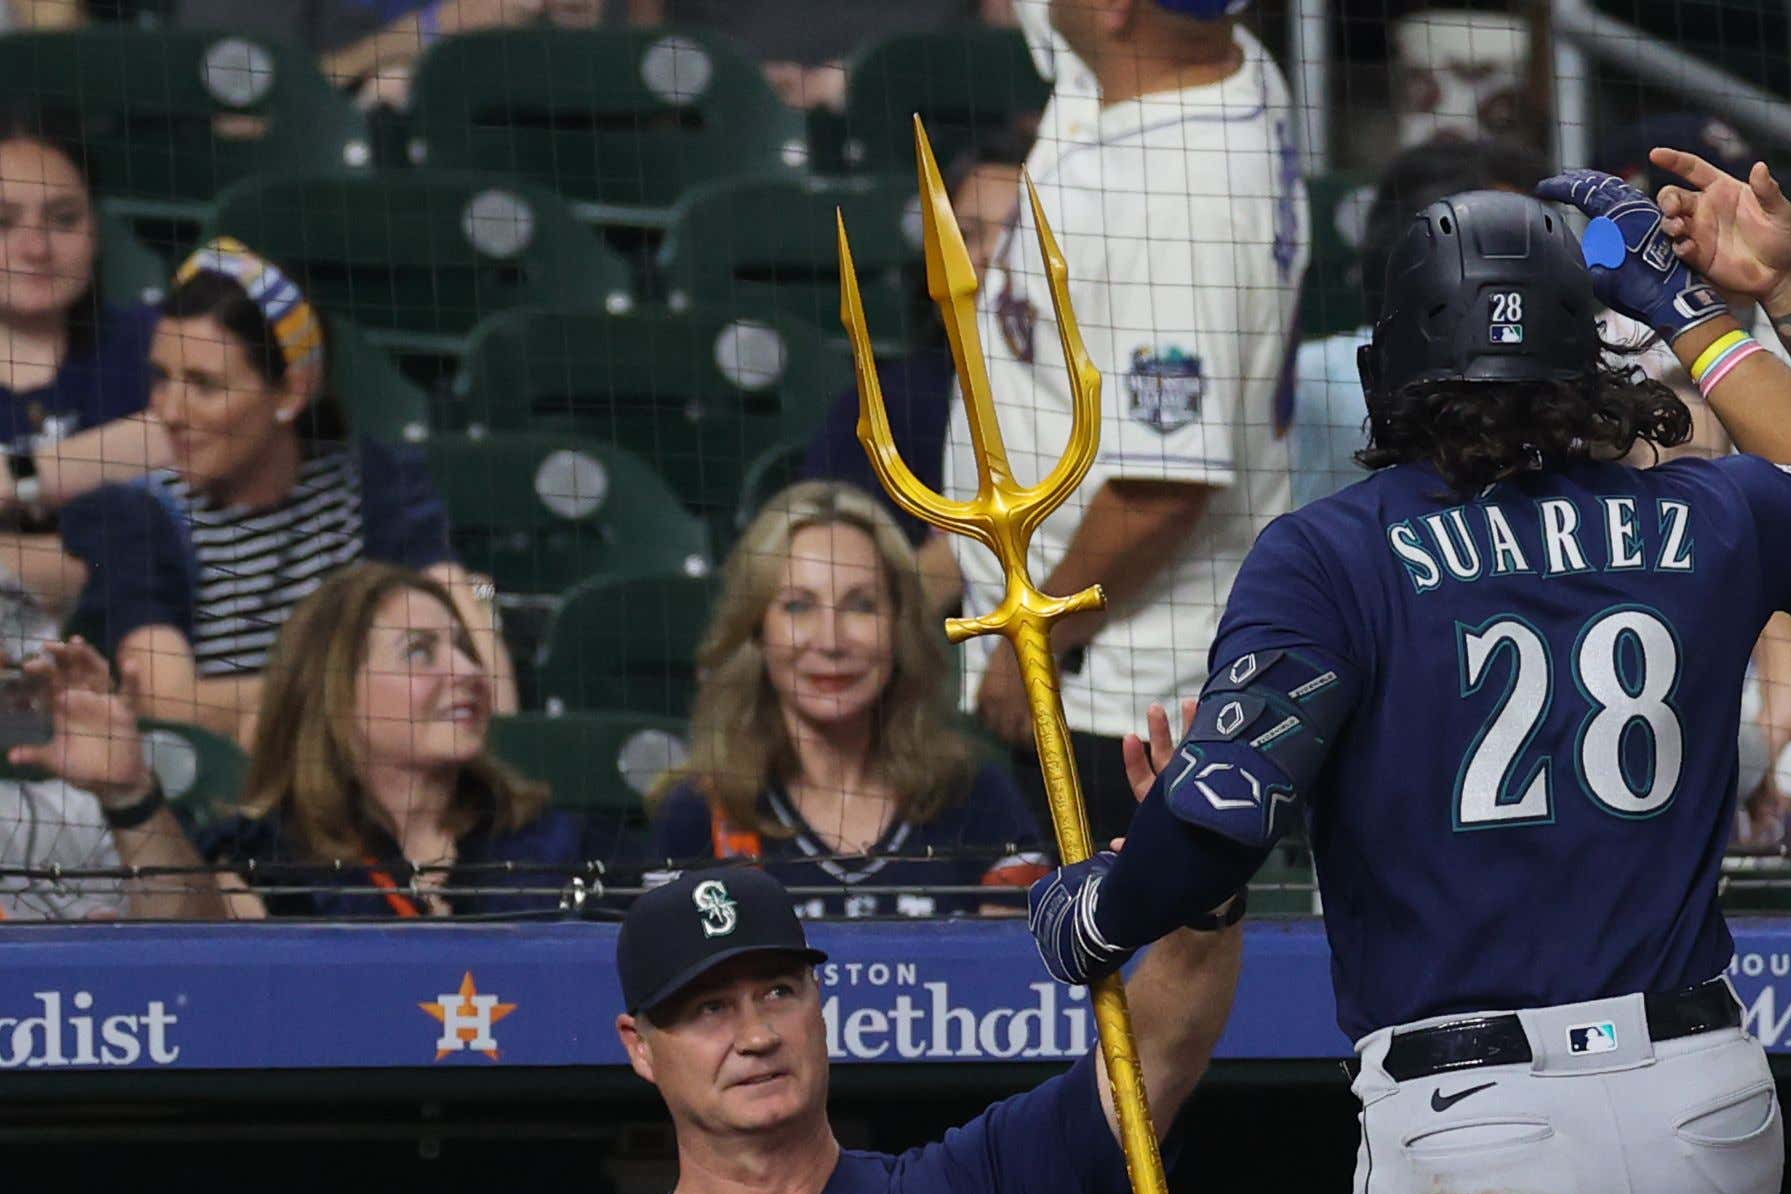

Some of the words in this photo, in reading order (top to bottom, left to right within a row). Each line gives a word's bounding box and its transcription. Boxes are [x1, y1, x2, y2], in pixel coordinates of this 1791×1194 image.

[1492, 292, 1522, 322] 28
[1455, 606, 1686, 828] 28
[814, 963, 917, 986] STON
[822, 981, 1097, 1059] ethodi
